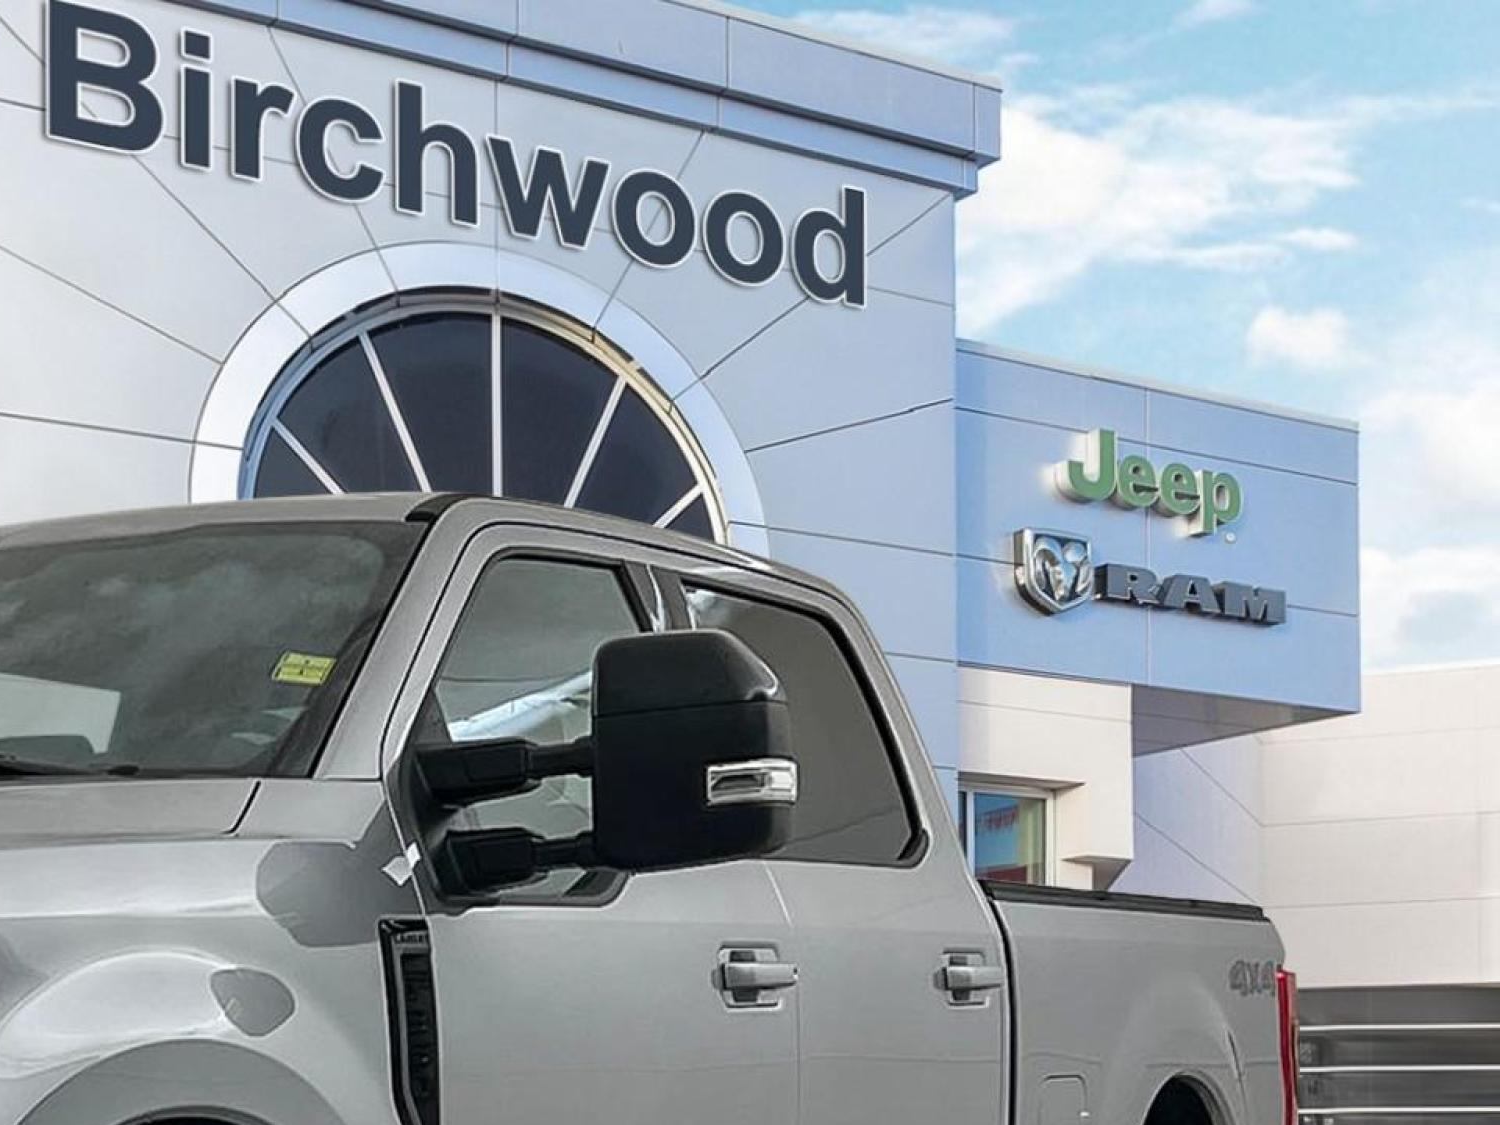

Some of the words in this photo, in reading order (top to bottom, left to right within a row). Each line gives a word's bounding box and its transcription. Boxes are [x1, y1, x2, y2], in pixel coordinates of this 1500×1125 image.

[46, 0, 866, 308] Birchwood
[1056, 428, 1242, 537] Jeep
[1094, 563, 1287, 625] RAM
